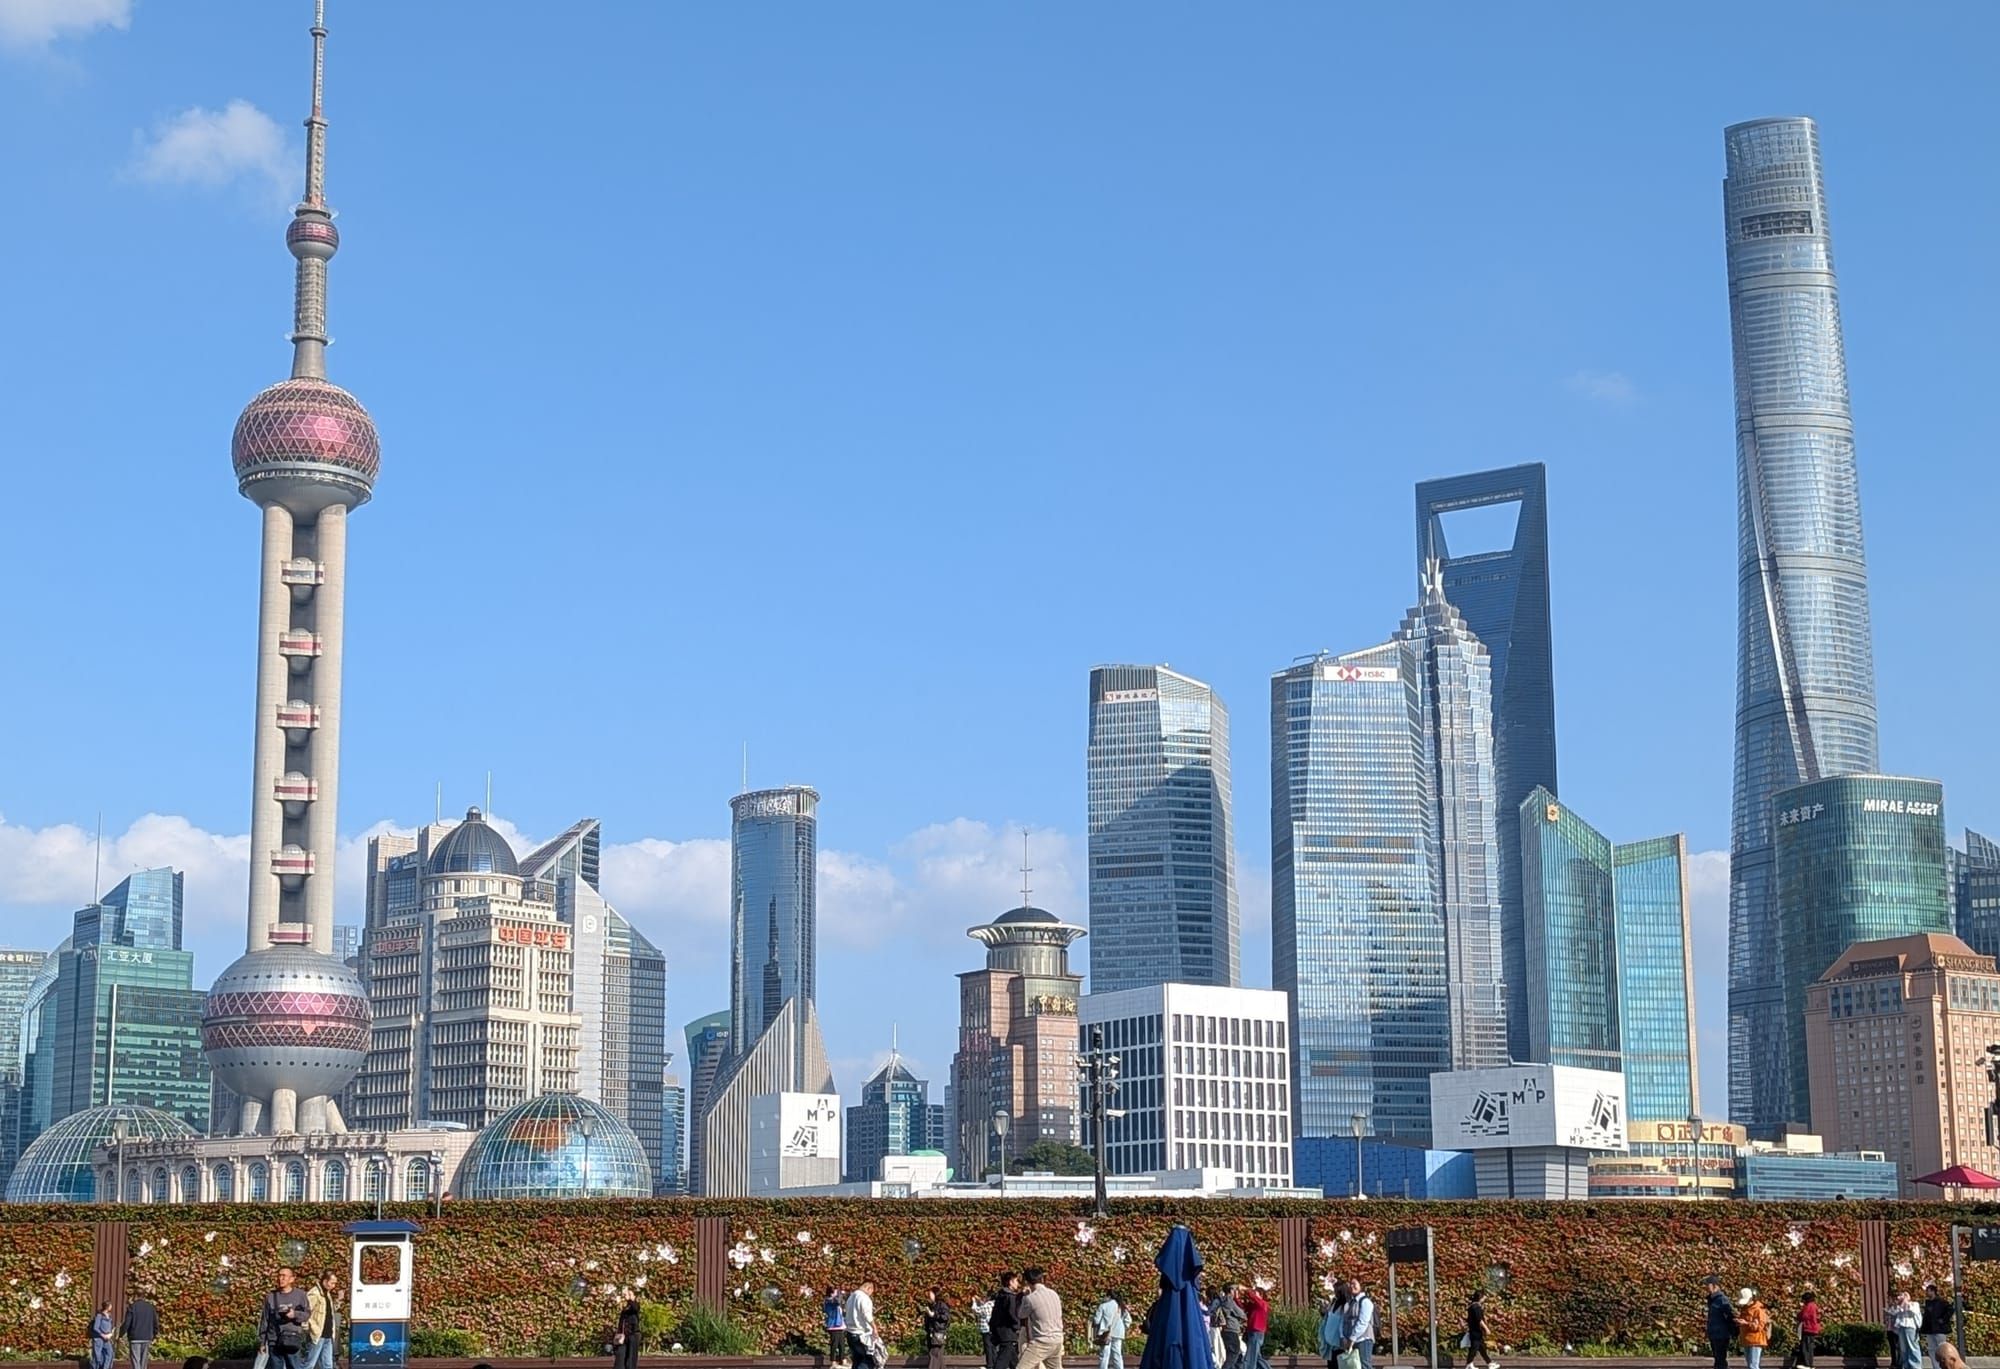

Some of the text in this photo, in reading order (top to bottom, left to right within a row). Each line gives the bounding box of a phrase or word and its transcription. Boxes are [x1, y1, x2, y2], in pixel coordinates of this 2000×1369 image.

[1863, 798, 1939, 817] MIRAE ASSET
[498, 925, 567, 950] 中国平安
[107, 949, 153, 965] 汇亚大厦
[1512, 1078, 1546, 1105] MAP
[807, 1098, 836, 1122] MAP
